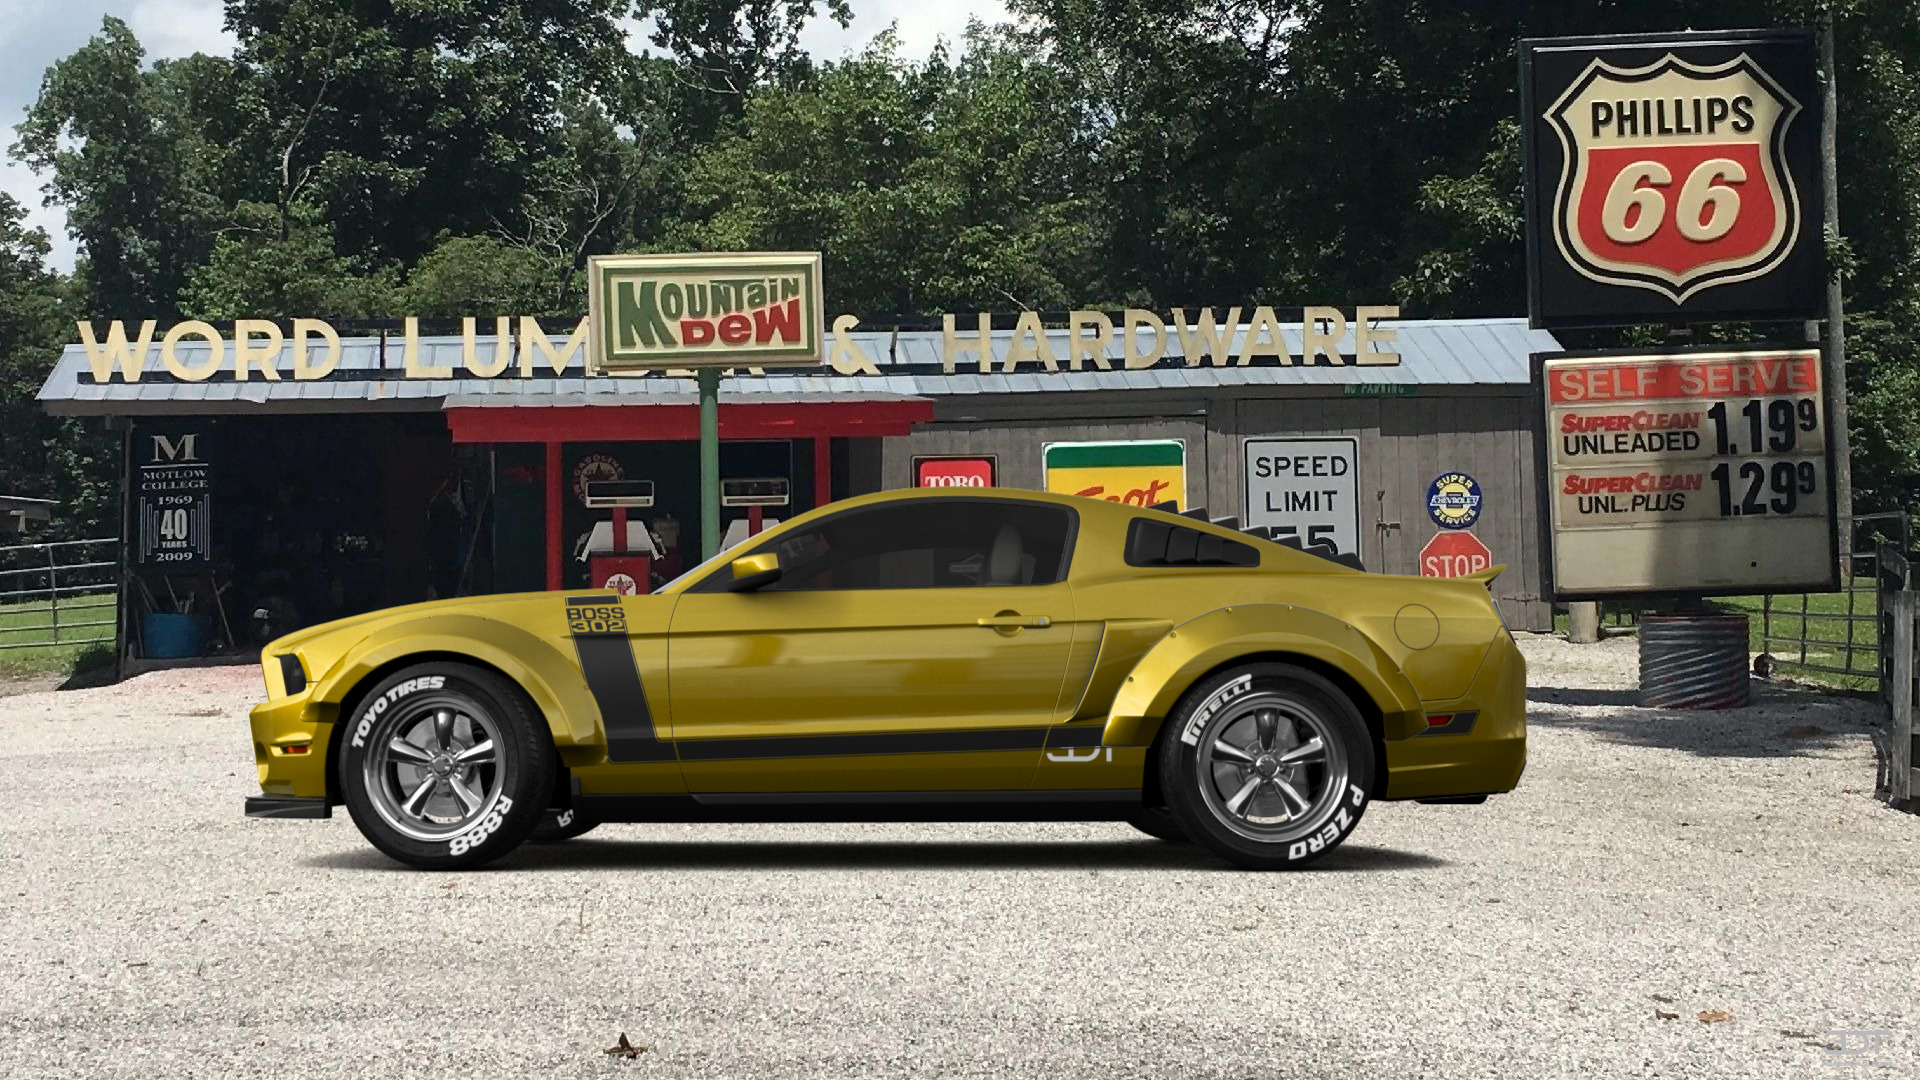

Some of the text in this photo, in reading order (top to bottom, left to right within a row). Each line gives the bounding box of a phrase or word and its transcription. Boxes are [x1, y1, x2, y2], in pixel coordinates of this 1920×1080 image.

[1591, 95, 1755, 138] PHILLIPS
[1601, 157, 1747, 244] 66
[77, 318, 341, 383] WORD
[831, 314, 881, 376] &
[943, 305, 1401, 373] HARDWARE
[1559, 359, 1809, 401] SELF SERVE
[150, 433, 199, 462] M
[1563, 430, 1700, 456] UNLEADED
[143, 469, 208, 480] MOTLOW
[1255, 455, 1348, 478] SPEED
[141, 480, 208, 491] COLLEGE
[1435, 474, 1474, 490] SUPER
[158, 495, 193, 505] 1969
[1265, 490, 1338, 512] LIMIT
[1432, 496, 1477, 505] CHEVROLET
[160, 508, 188, 540] 40
[1433, 508, 1476, 525] SERVICE
[161, 540, 188, 549] YEARS
[156, 552, 193, 562] 2009
[1426, 554, 1486, 578] STOP
[566, 606, 626, 620] BOSS
[570, 619, 626, 633] 302
[351, 675, 446, 749] TOYO TIRES
[1180, 673, 1252, 746] PIRELLI
[448, 795, 513, 857] R888
[1288, 783, 1365, 861] P ZERO
